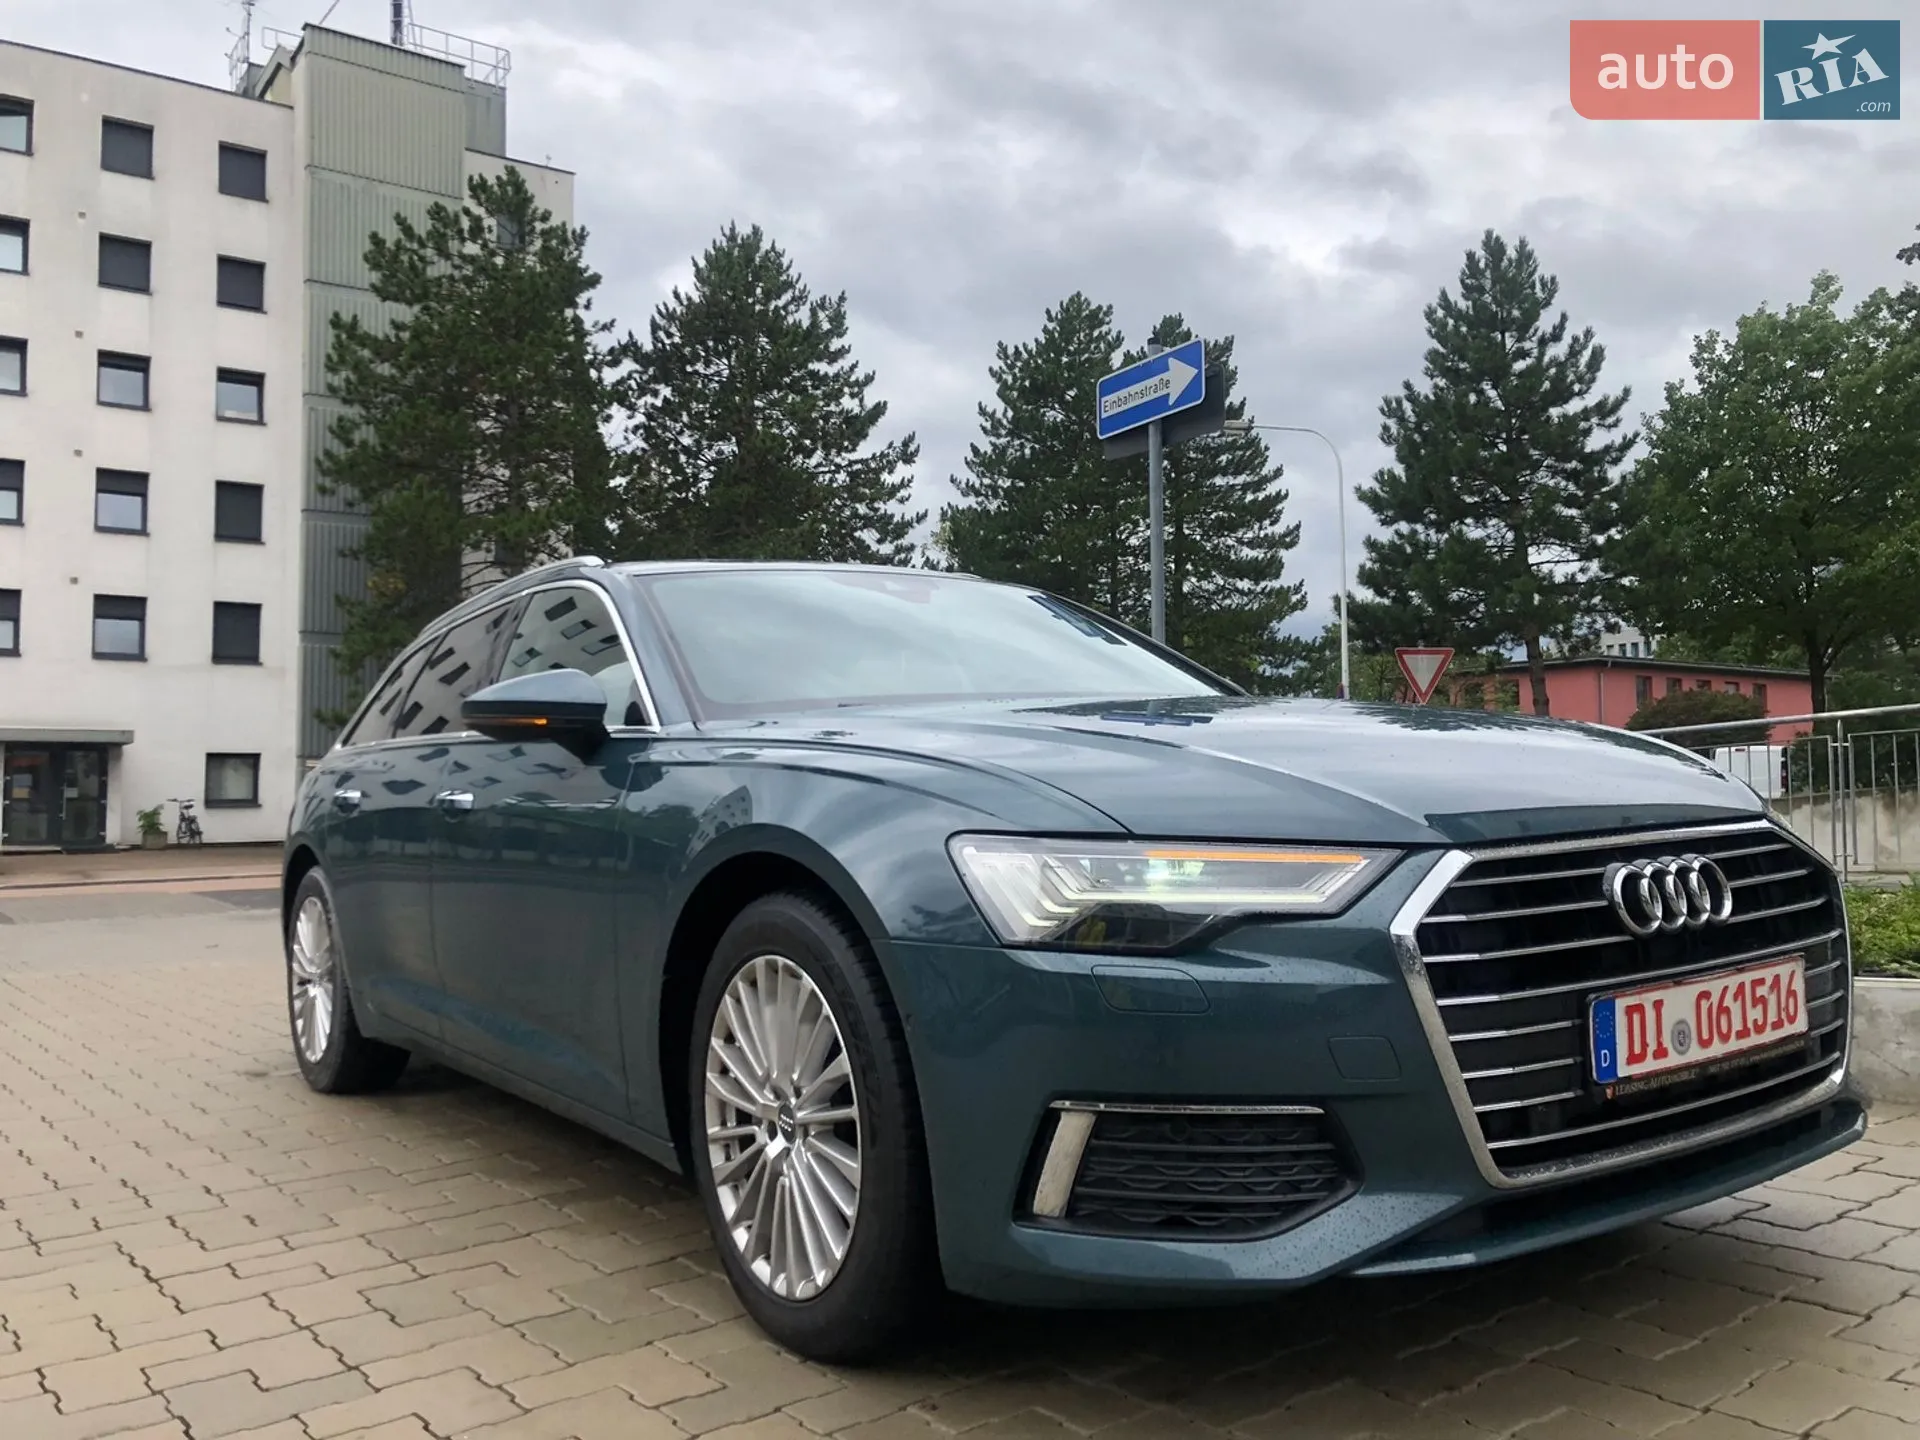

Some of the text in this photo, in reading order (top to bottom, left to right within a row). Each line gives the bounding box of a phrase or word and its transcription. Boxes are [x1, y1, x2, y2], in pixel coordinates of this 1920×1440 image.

[1103, 378, 1171, 413] Einbahnstraße
[1625, 999, 1669, 1066] DI
[1695, 969, 1799, 1049] 061516
[1600, 1049, 1611, 1068] D
